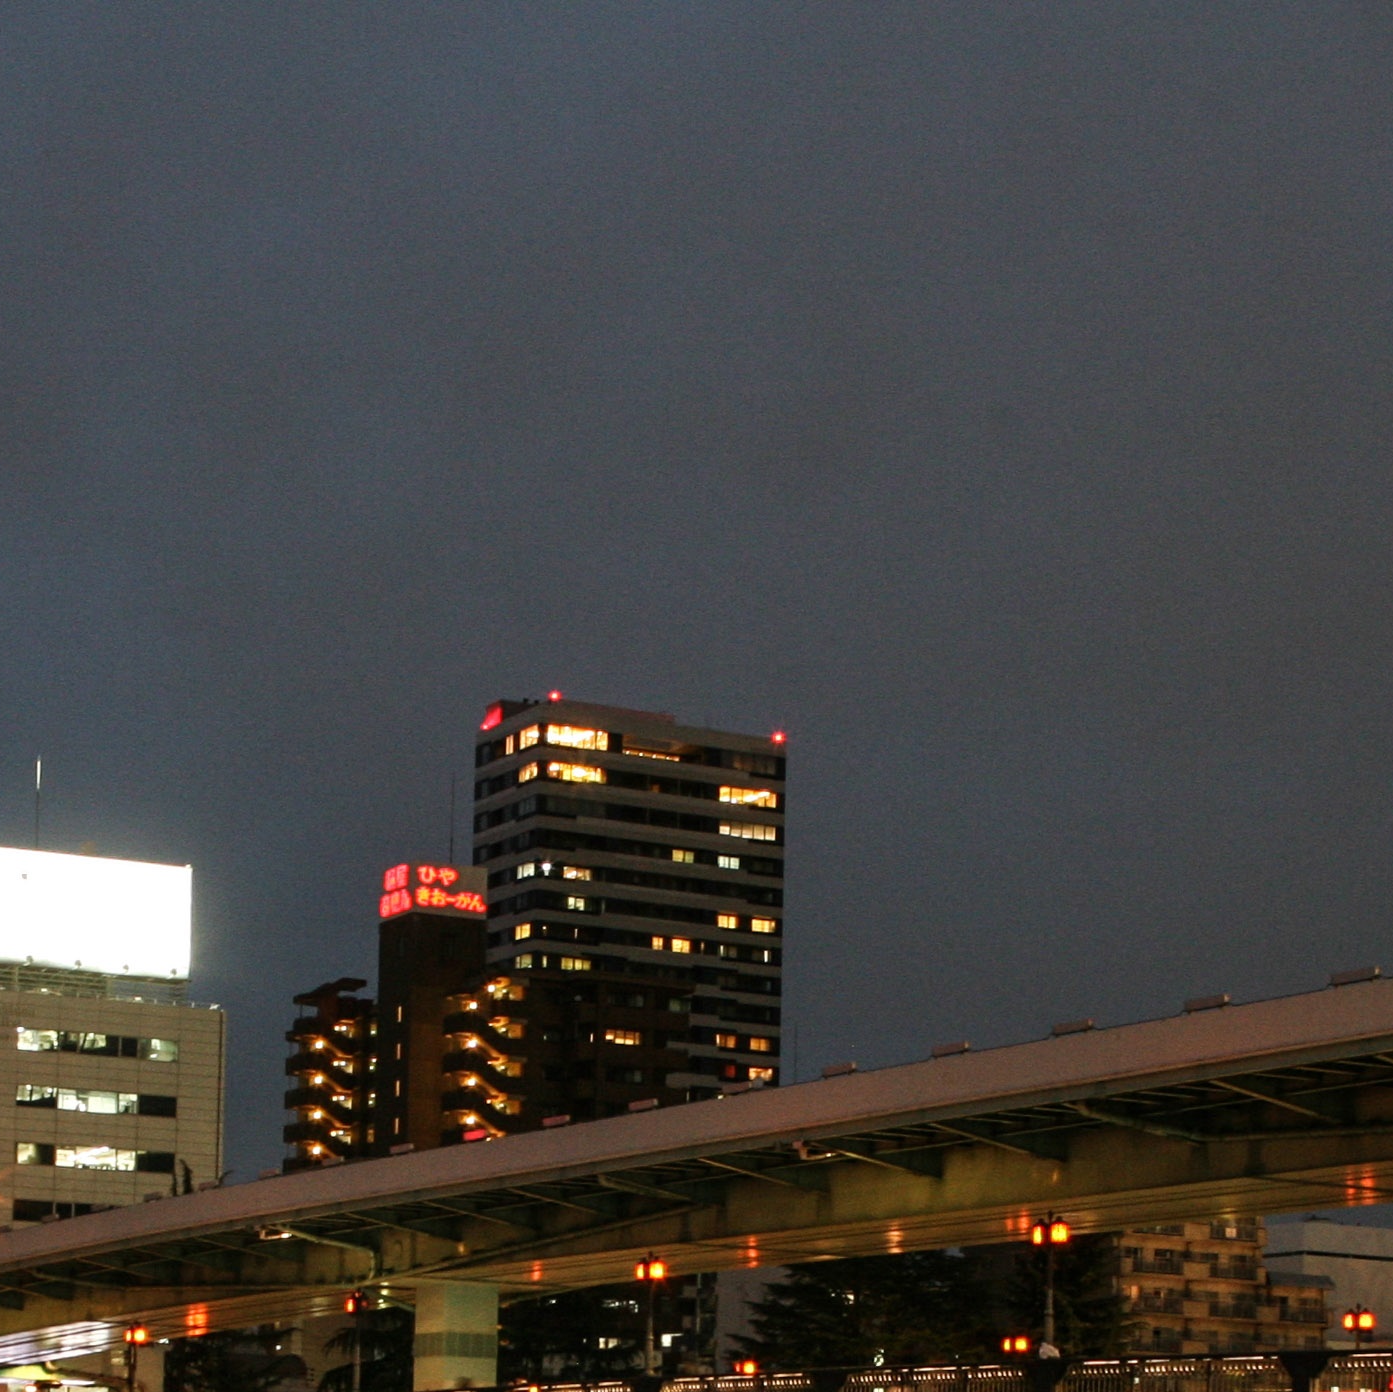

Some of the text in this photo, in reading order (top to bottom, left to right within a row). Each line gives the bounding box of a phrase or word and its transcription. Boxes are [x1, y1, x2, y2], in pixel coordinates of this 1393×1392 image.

[417, 865, 459, 886] ひや
[415, 887, 487, 912] きおーがん
